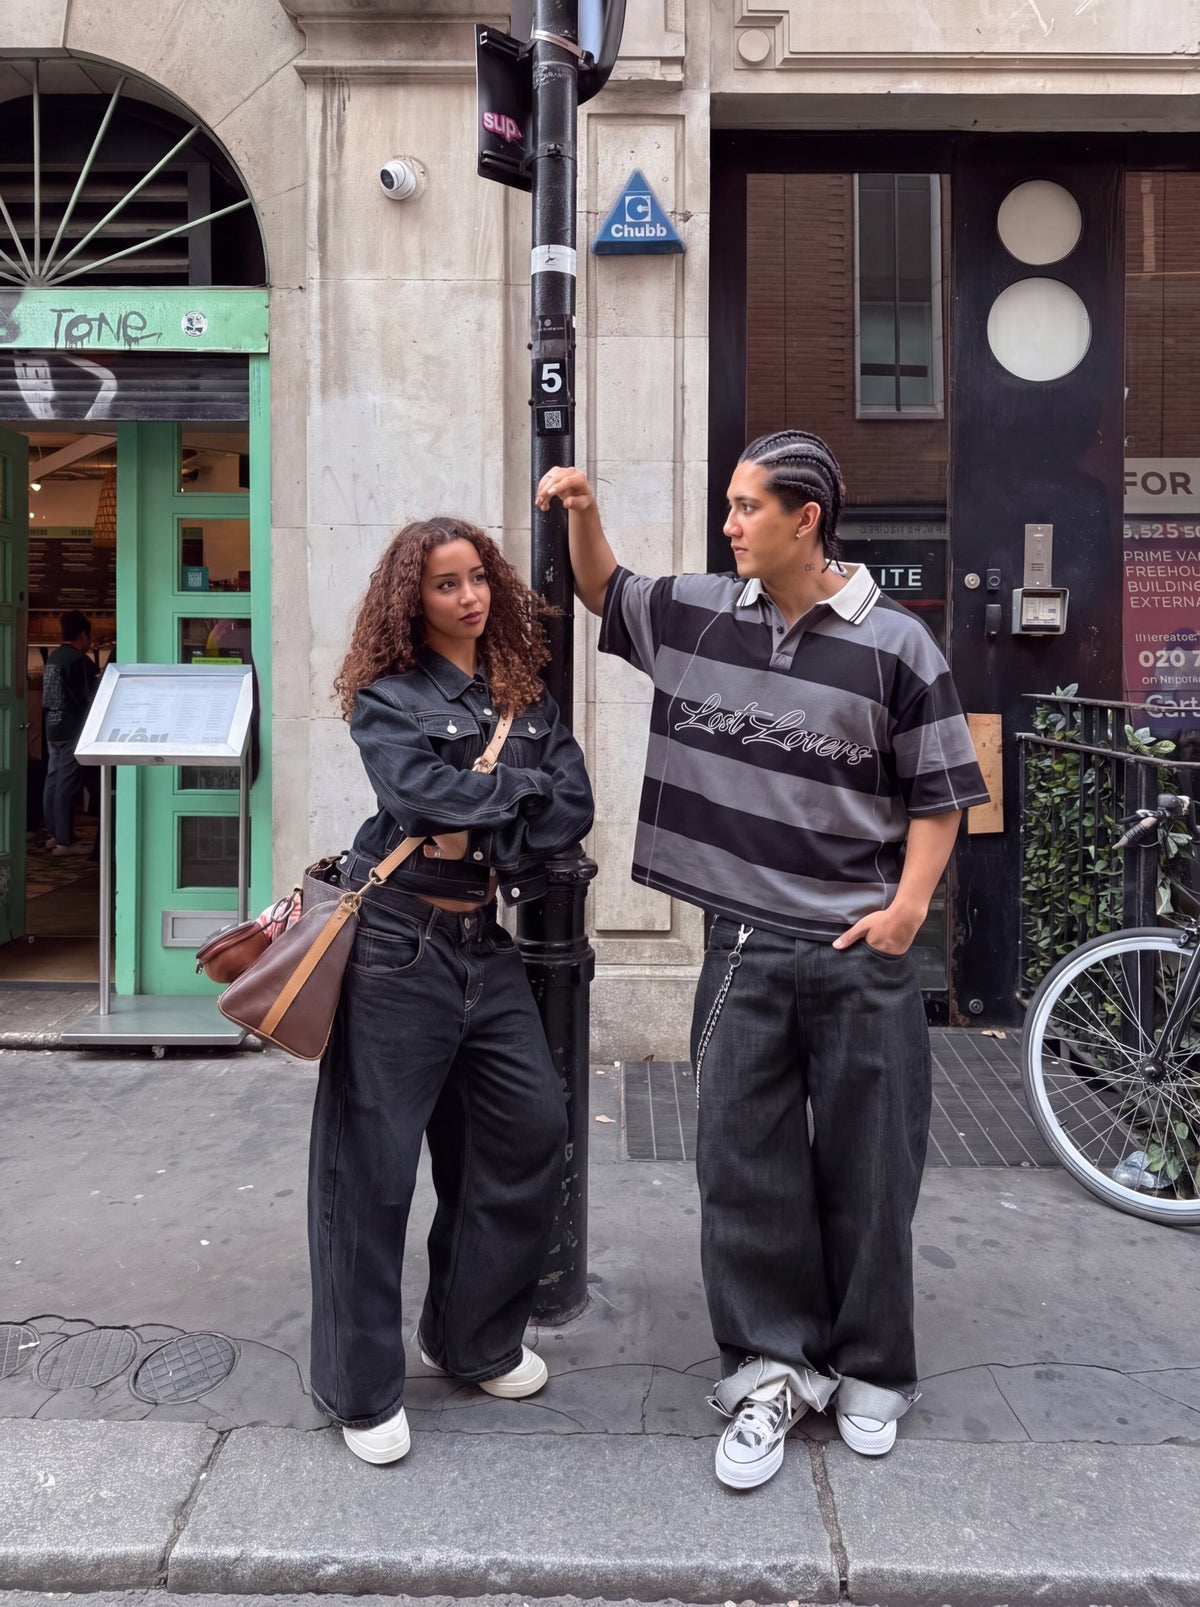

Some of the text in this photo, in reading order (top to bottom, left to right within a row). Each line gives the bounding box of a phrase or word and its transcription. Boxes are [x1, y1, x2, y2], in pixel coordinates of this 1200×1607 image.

[611, 223, 667, 237] Chubb
[541, 363, 562, 393] 5
[1124, 471, 1193, 495] FOR
[1123, 551, 1200, 562] PRIME VA
[867, 568, 922, 587] ITE
[1138, 650, 1186, 667] 020
[674, 692, 873, 765] Lost Lovers
